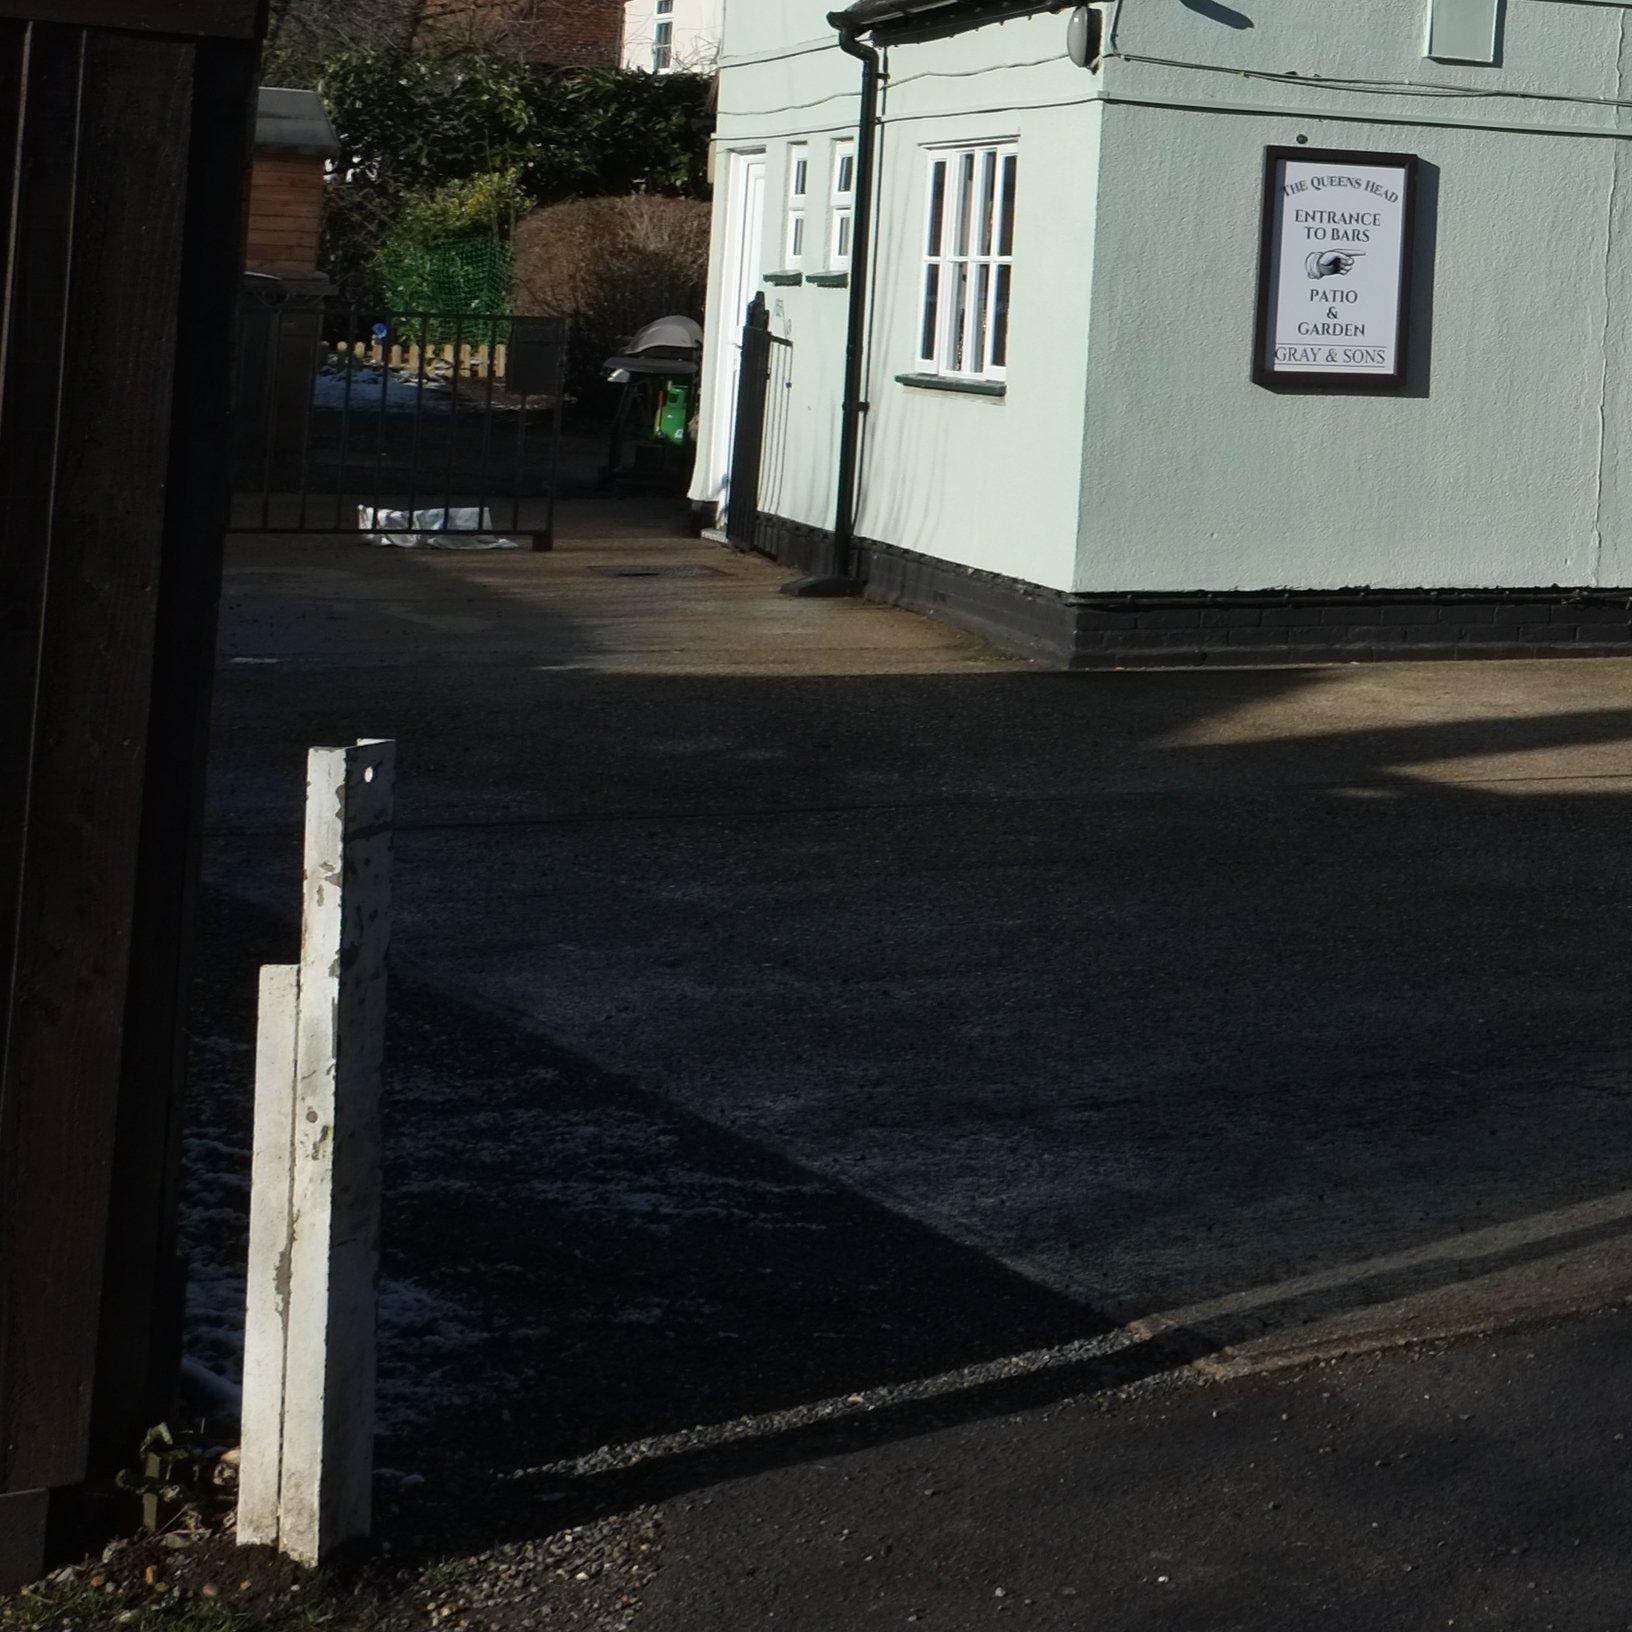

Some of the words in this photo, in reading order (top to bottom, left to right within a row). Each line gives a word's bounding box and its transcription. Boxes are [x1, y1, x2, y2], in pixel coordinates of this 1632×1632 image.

[1282, 179, 1308, 197] THE
[1364, 180, 1399, 203] HEAD
[1295, 209, 1381, 226] ENTRANCE
[1305, 226, 1327, 240] TO
[1331, 228, 1370, 243] BARS
[1309, 289, 1358, 304] PATIO
[1327, 306, 1338, 319] &
[1297, 322, 1366, 337] GARDEN
[1275, 347, 1322, 363] GRAY
[1325, 348, 1338, 363] &
[1343, 349, 1386, 364] SONS
